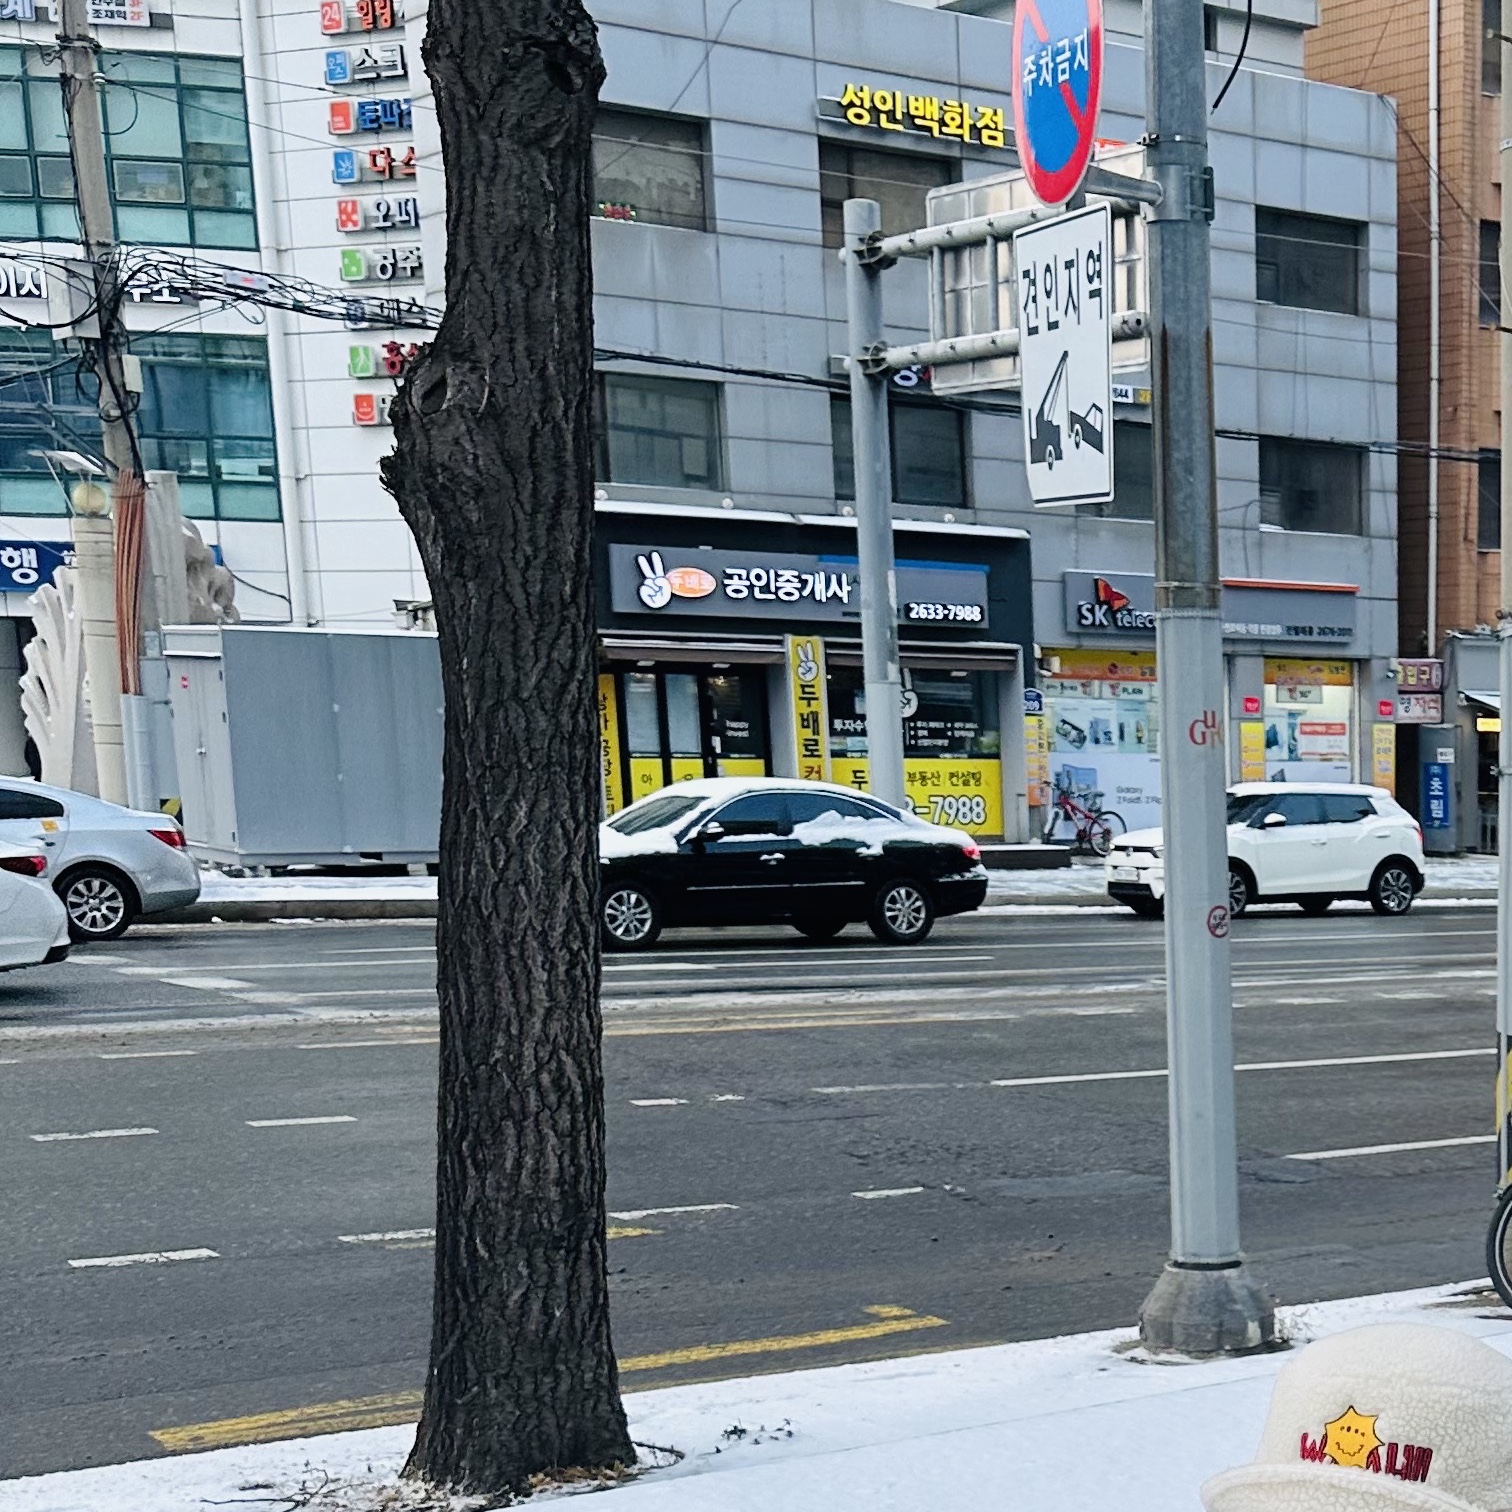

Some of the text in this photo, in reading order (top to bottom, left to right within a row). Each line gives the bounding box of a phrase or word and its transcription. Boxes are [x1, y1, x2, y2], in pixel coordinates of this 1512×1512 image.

[1022, 28, 1089, 98] 주차금지
[841, 83, 1005, 148] 성인백화점
[1022, 240, 1104, 337] 견인지역
[723, 568, 852, 604] 공인중개사
[909, 602, 982, 622] 2633-7988
[1080, 604, 1109, 626] SK
[799, 684, 822, 758] 두배로
[907, 770, 942, 787] 부동산
